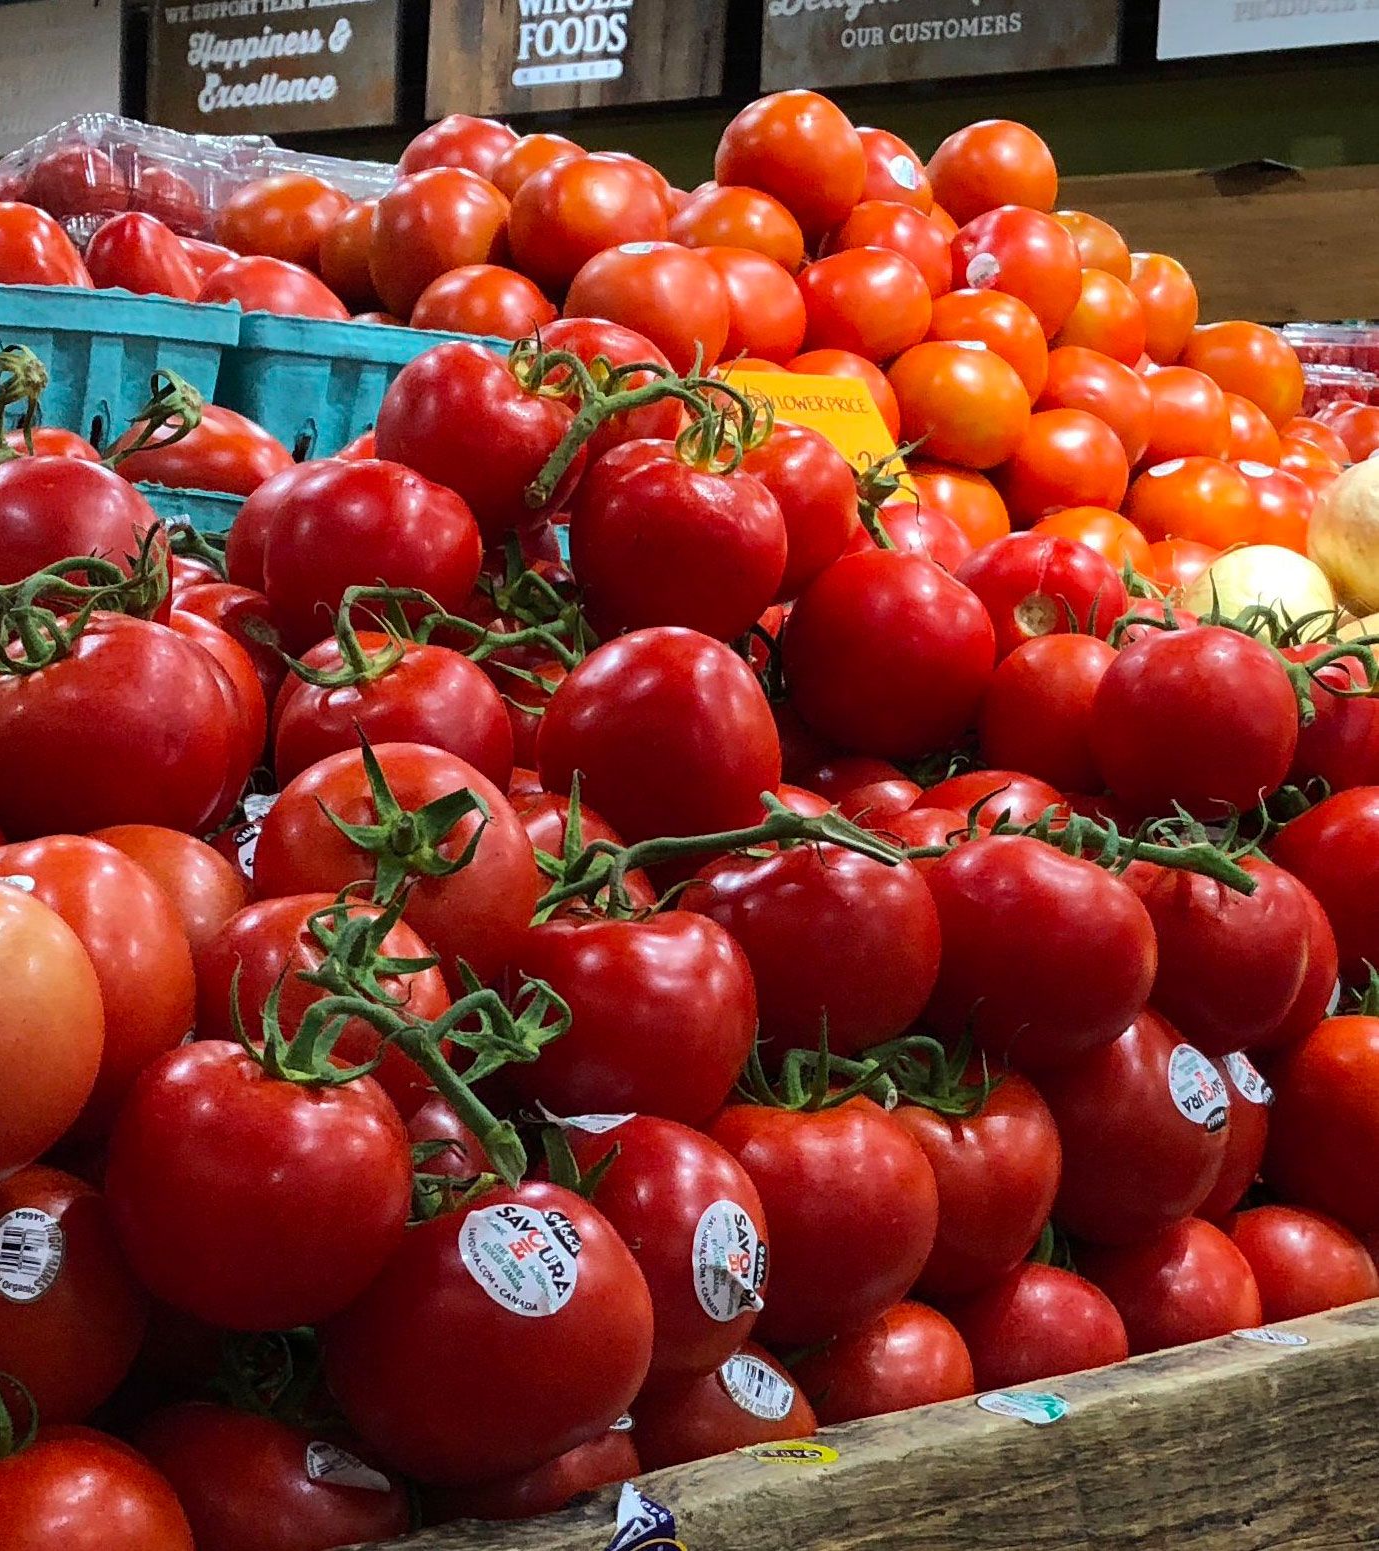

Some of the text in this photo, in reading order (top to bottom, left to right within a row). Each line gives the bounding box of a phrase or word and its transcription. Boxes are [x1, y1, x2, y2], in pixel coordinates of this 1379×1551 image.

[187, 18, 352, 70] Happiness &
[517, 13, 628, 60] FOODS
[841, 12, 1022, 48] OUR CUSTOMERS
[197, 73, 339, 113] Excellence
[779, 395, 829, 412] LOWER
[829, 396, 870, 414] PRICE
[2, 1280, 36, 1295] Organic
[499, 1288, 539, 1312] CANADA
